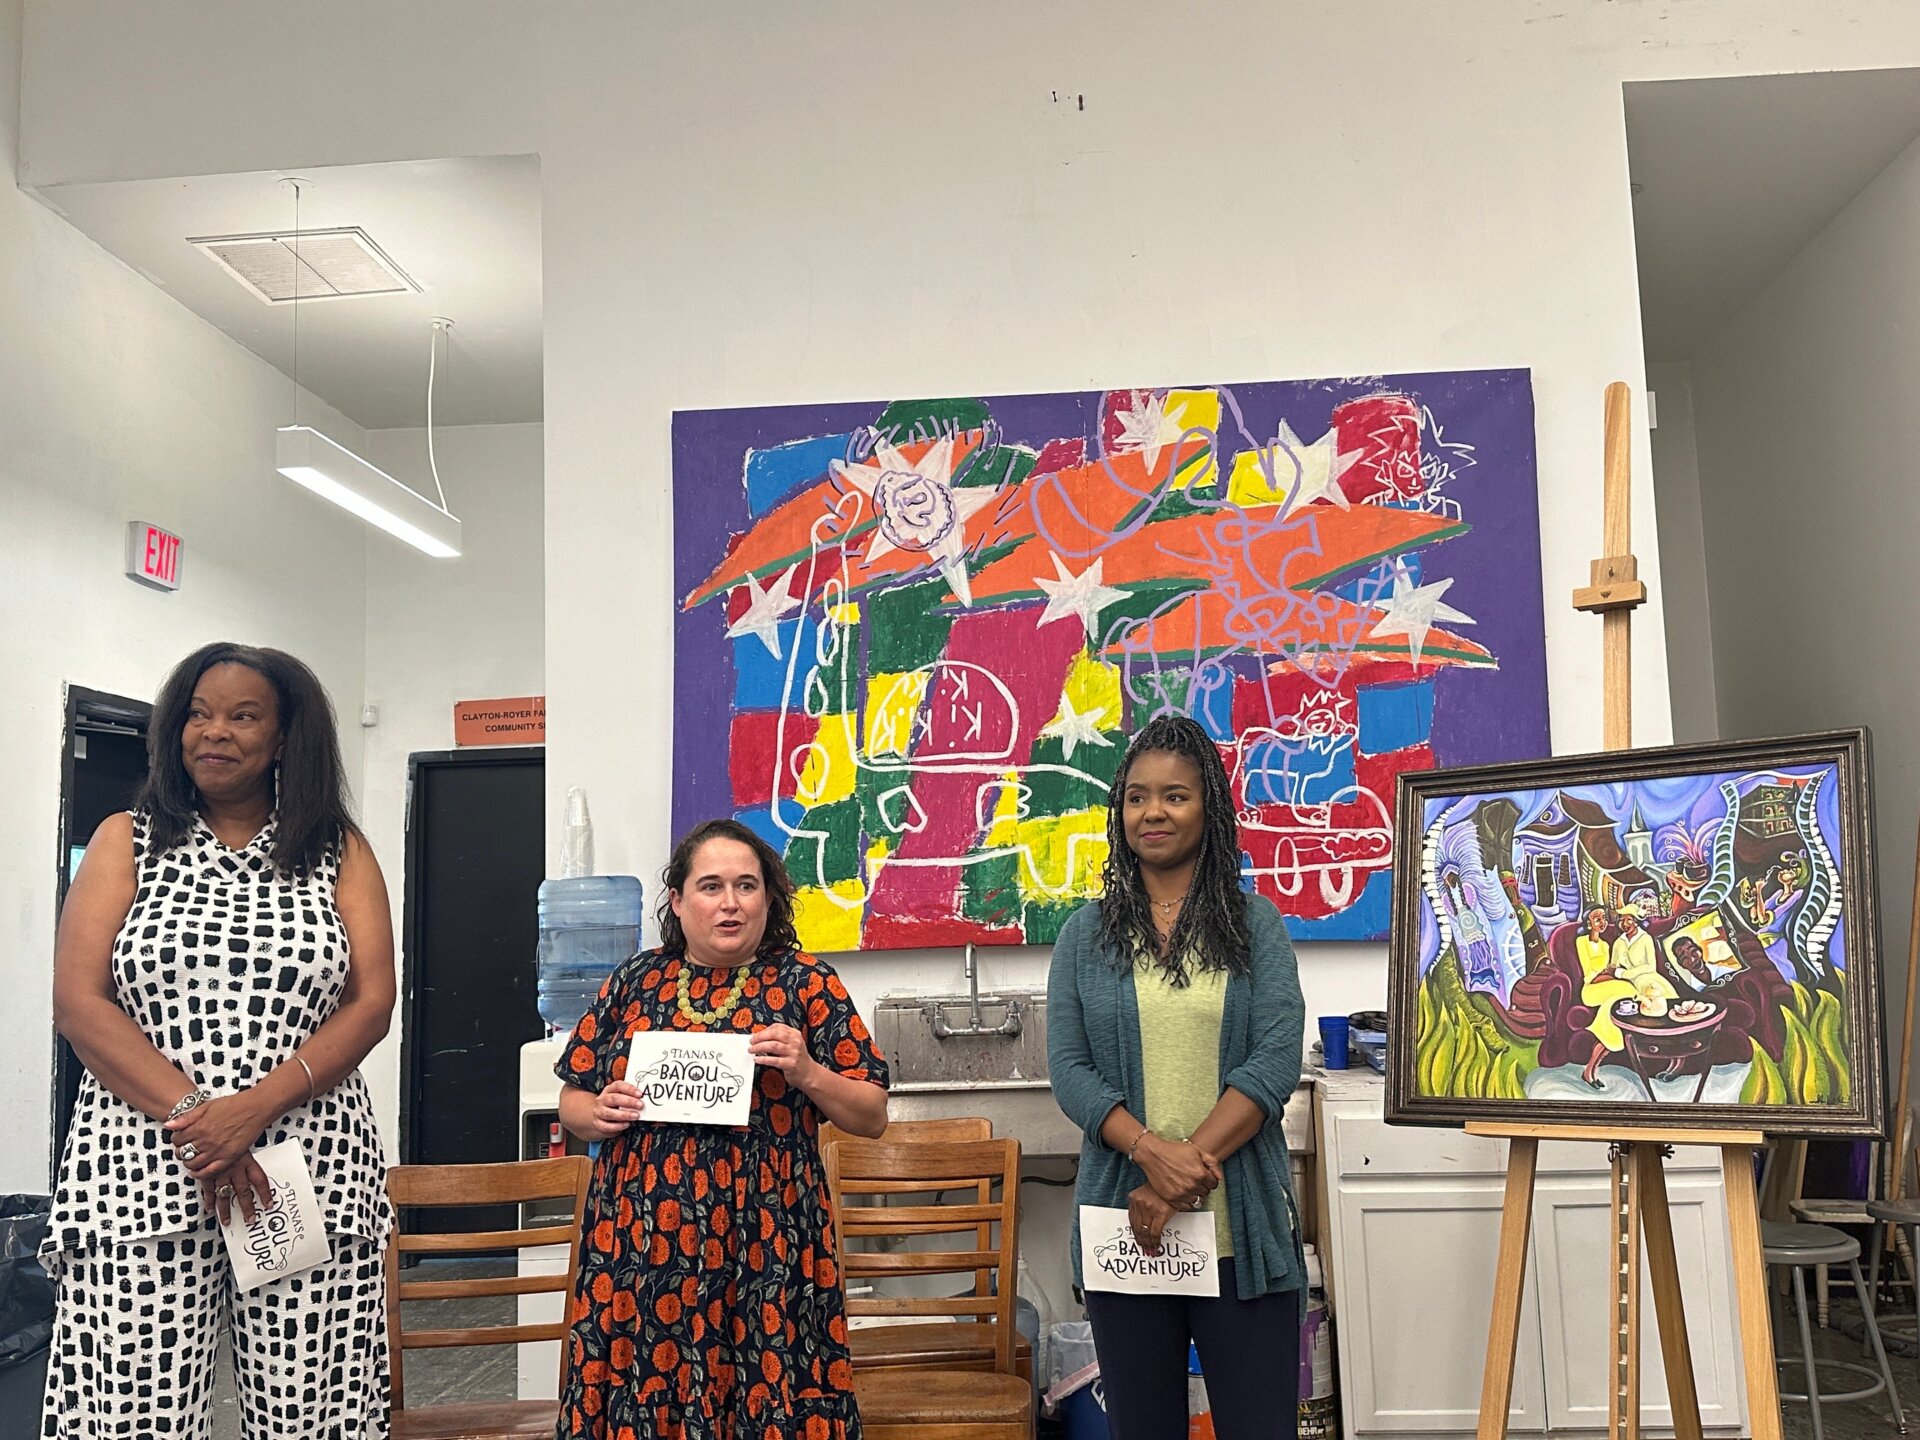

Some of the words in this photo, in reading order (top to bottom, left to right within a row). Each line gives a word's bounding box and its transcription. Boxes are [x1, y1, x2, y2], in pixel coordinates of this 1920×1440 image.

[145, 527, 180, 583] EXIT
[462, 710, 531, 721] CLAYTON-ROYER
[485, 723, 536, 732] COMMUNITY
[538, 722, 546, 730] S
[660, 1061, 718, 1082] BAYOU
[641, 1081, 736, 1106] ADVENTURE
[1103, 1257, 1202, 1279] ADVENTURE
